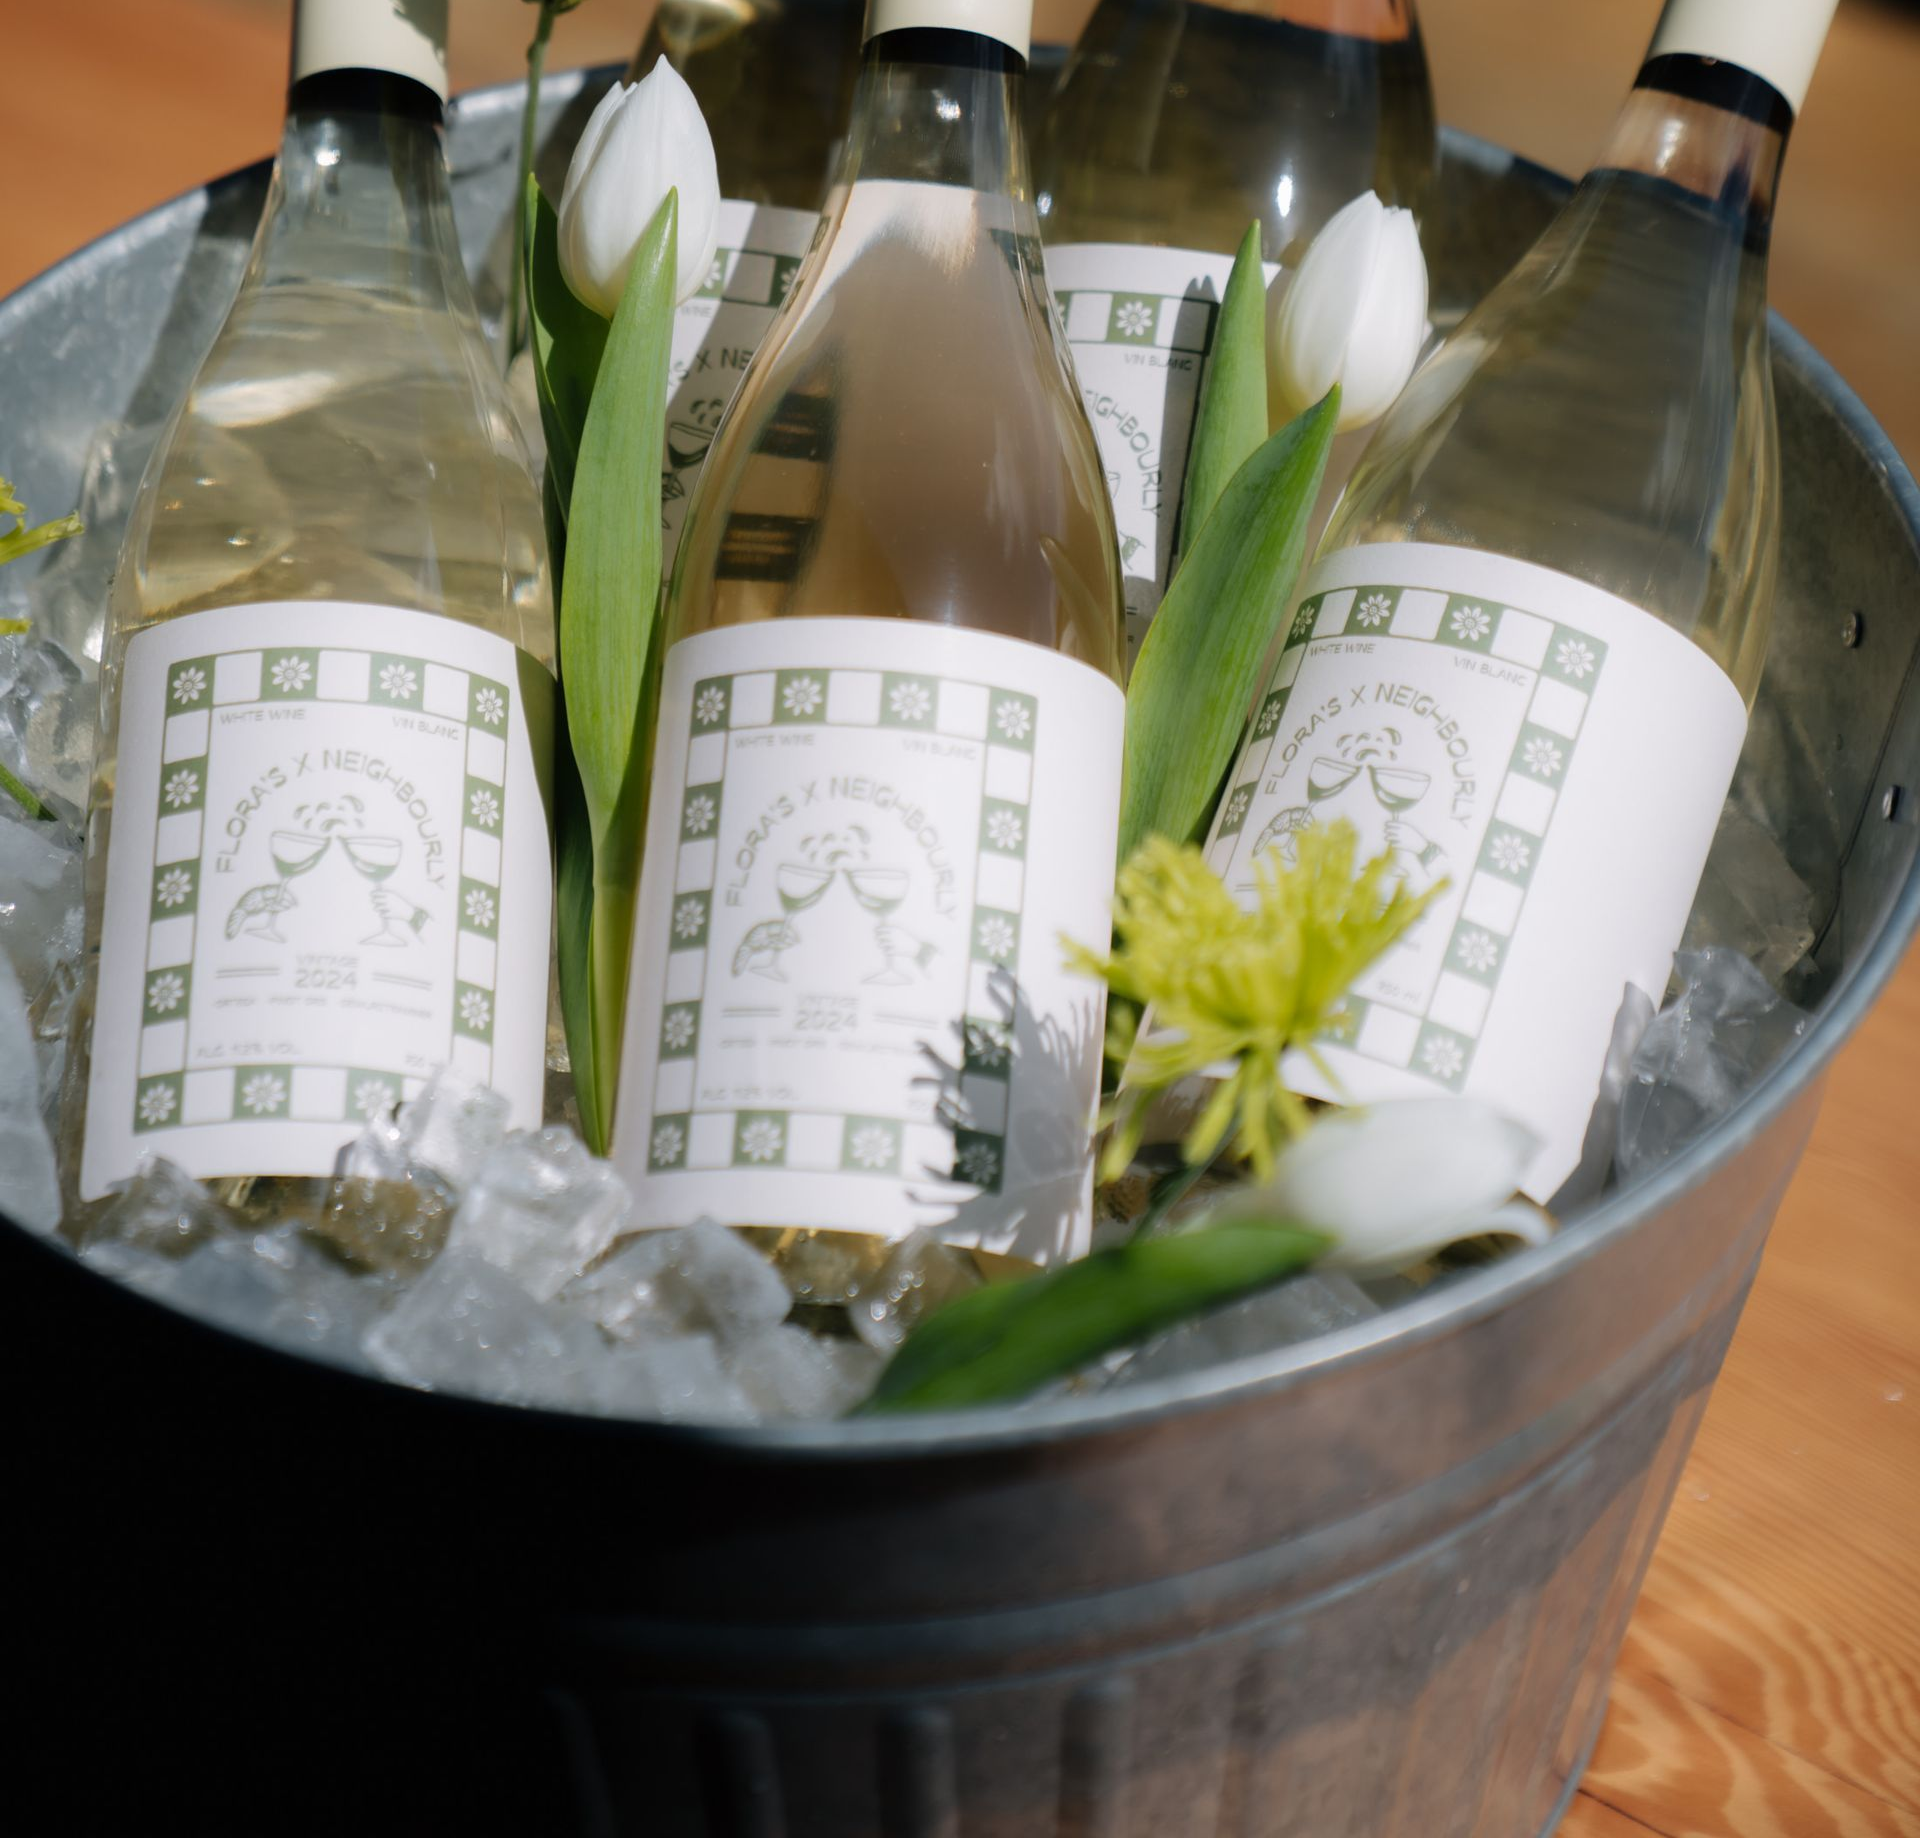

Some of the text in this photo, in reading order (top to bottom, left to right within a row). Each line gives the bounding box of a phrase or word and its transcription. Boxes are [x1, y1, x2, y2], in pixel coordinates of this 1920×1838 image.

[1124, 353, 1193, 372] VIN BLANC
[1310, 642, 1376, 658] WHITE WINE
[1454, 655, 1529, 687] VIN BLANC
[219, 708, 306, 726] WHITE WINE
[392, 716, 460, 741] VIN BLANC
[1264, 682, 1476, 830] FLORA'S X NEIGHBOURLY
[215, 749, 446, 891] FLORA'S X NEIGHBOURLY
[724, 776, 957, 922] FLORA'S X NEIGHBOURLY
[294, 968, 358, 991] 2024
